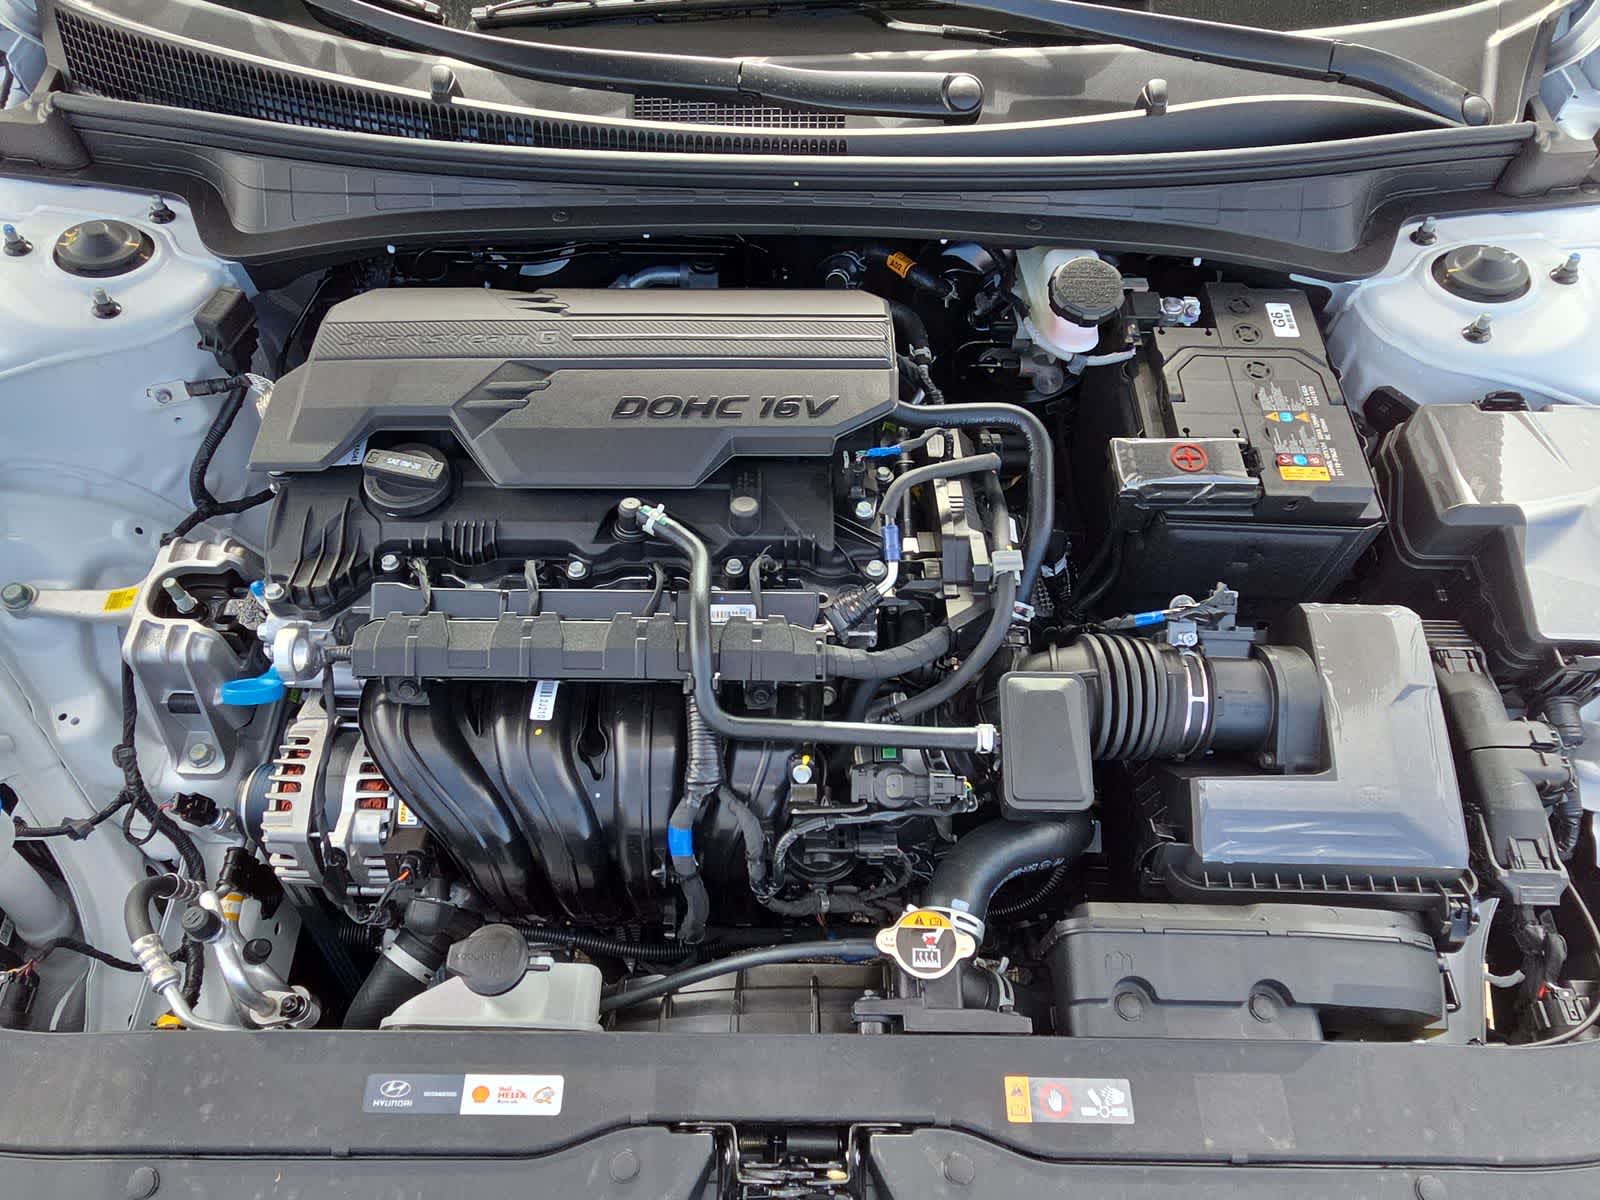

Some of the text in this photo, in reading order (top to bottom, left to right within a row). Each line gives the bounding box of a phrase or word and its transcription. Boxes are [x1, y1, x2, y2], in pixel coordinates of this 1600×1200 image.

[1270, 312, 1286, 328] G6
[339, 331, 530, 347] Smartstream
[611, 394, 840, 419] DOHC 16V
[372, 1099, 413, 1108] HYUNDAI
